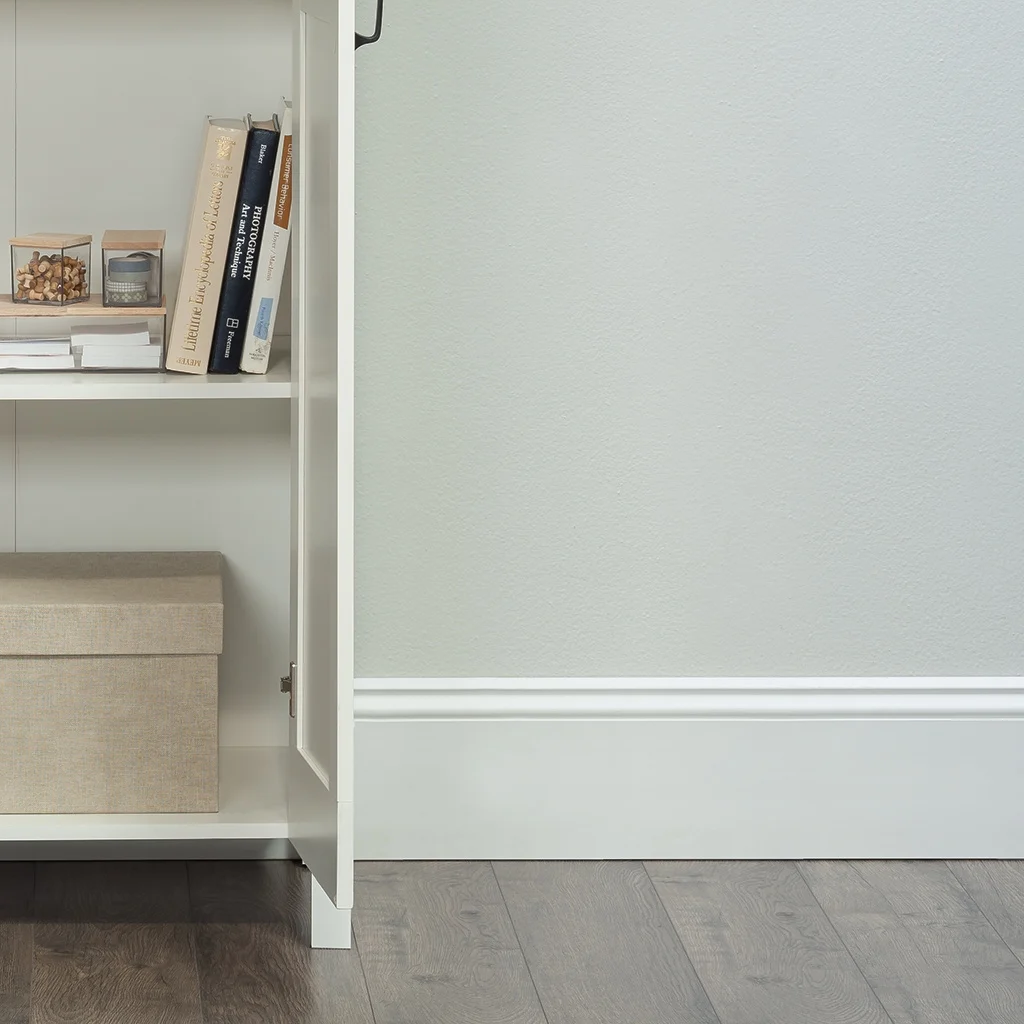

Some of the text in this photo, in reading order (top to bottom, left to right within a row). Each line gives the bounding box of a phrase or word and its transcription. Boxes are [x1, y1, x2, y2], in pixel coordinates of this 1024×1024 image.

[204, 180, 224, 217] Letters
[277, 183, 289, 220] Behavior
[203, 216, 217, 231] of
[230, 203, 250, 278] Art and Technique
[242, 205, 263, 281] PHOTOGRAPHY
[189, 234, 215, 305] Encyclopedia
[182, 306, 203, 352] Lifetime
[224, 330, 235, 358] Freeman
